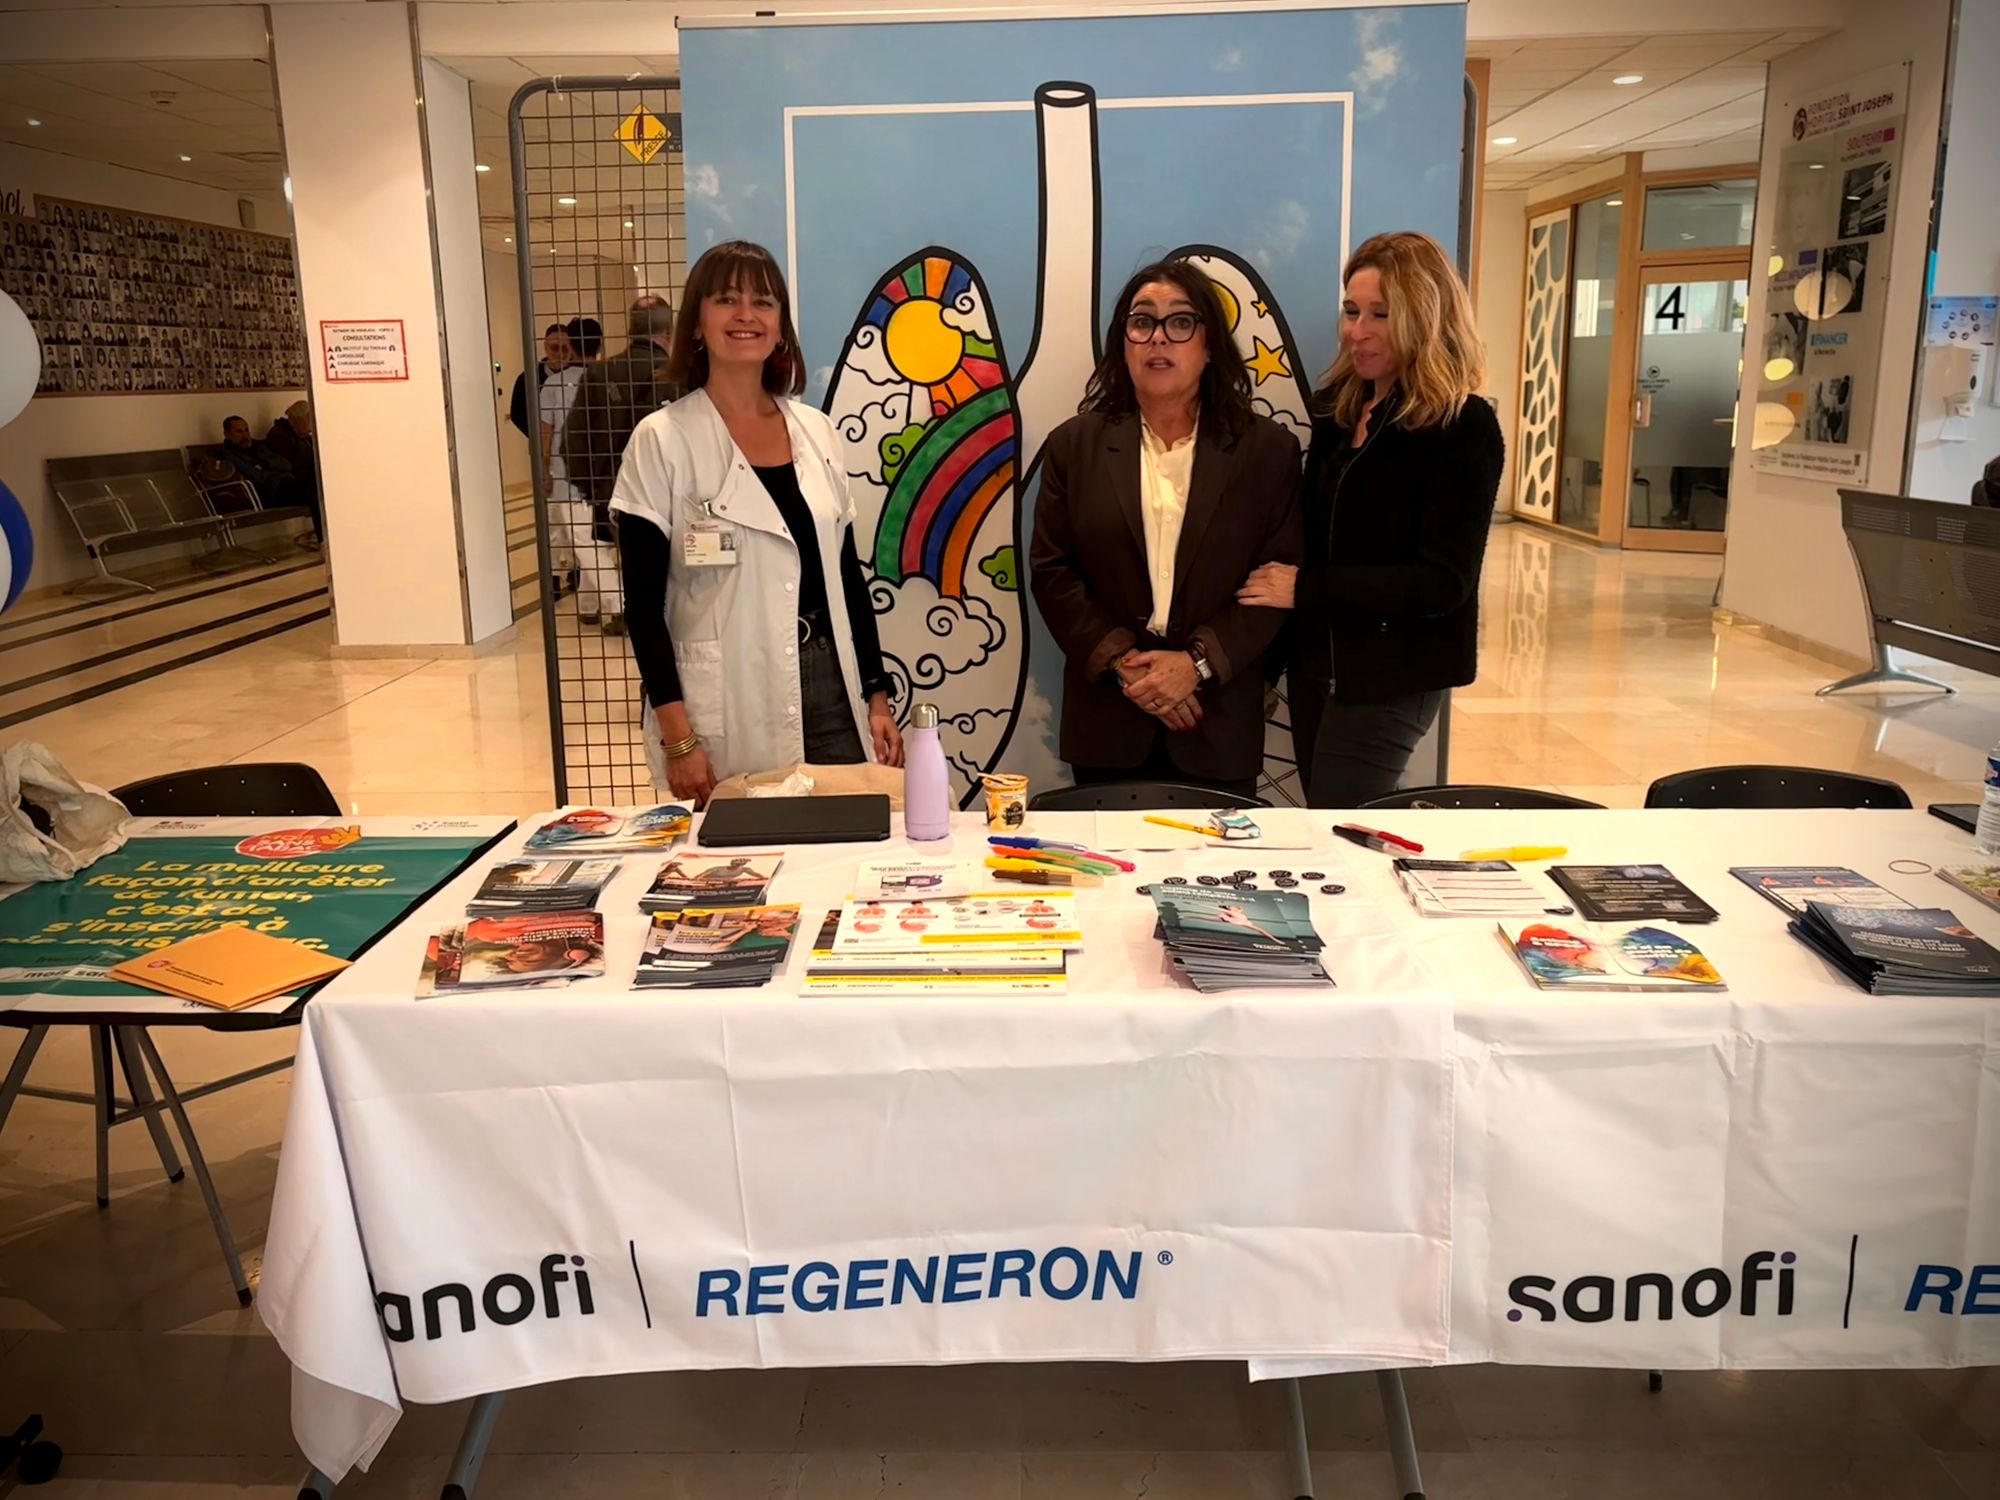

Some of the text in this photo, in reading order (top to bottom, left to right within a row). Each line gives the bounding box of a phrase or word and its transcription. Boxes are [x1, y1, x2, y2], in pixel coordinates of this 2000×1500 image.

[1655, 285, 1685, 330] 4
[134, 860, 385, 874] La meilleure
[84, 873, 396, 889] façon d'arrêter
[113, 888, 169, 899] de
[105, 902, 277, 916] c'est de
[41, 916, 289, 932] s'inscrire à
[367, 1253, 595, 1342] anofi
[696, 1246, 1142, 1317] REGENERON
[1507, 1250, 2000, 1323] sanofi RE
